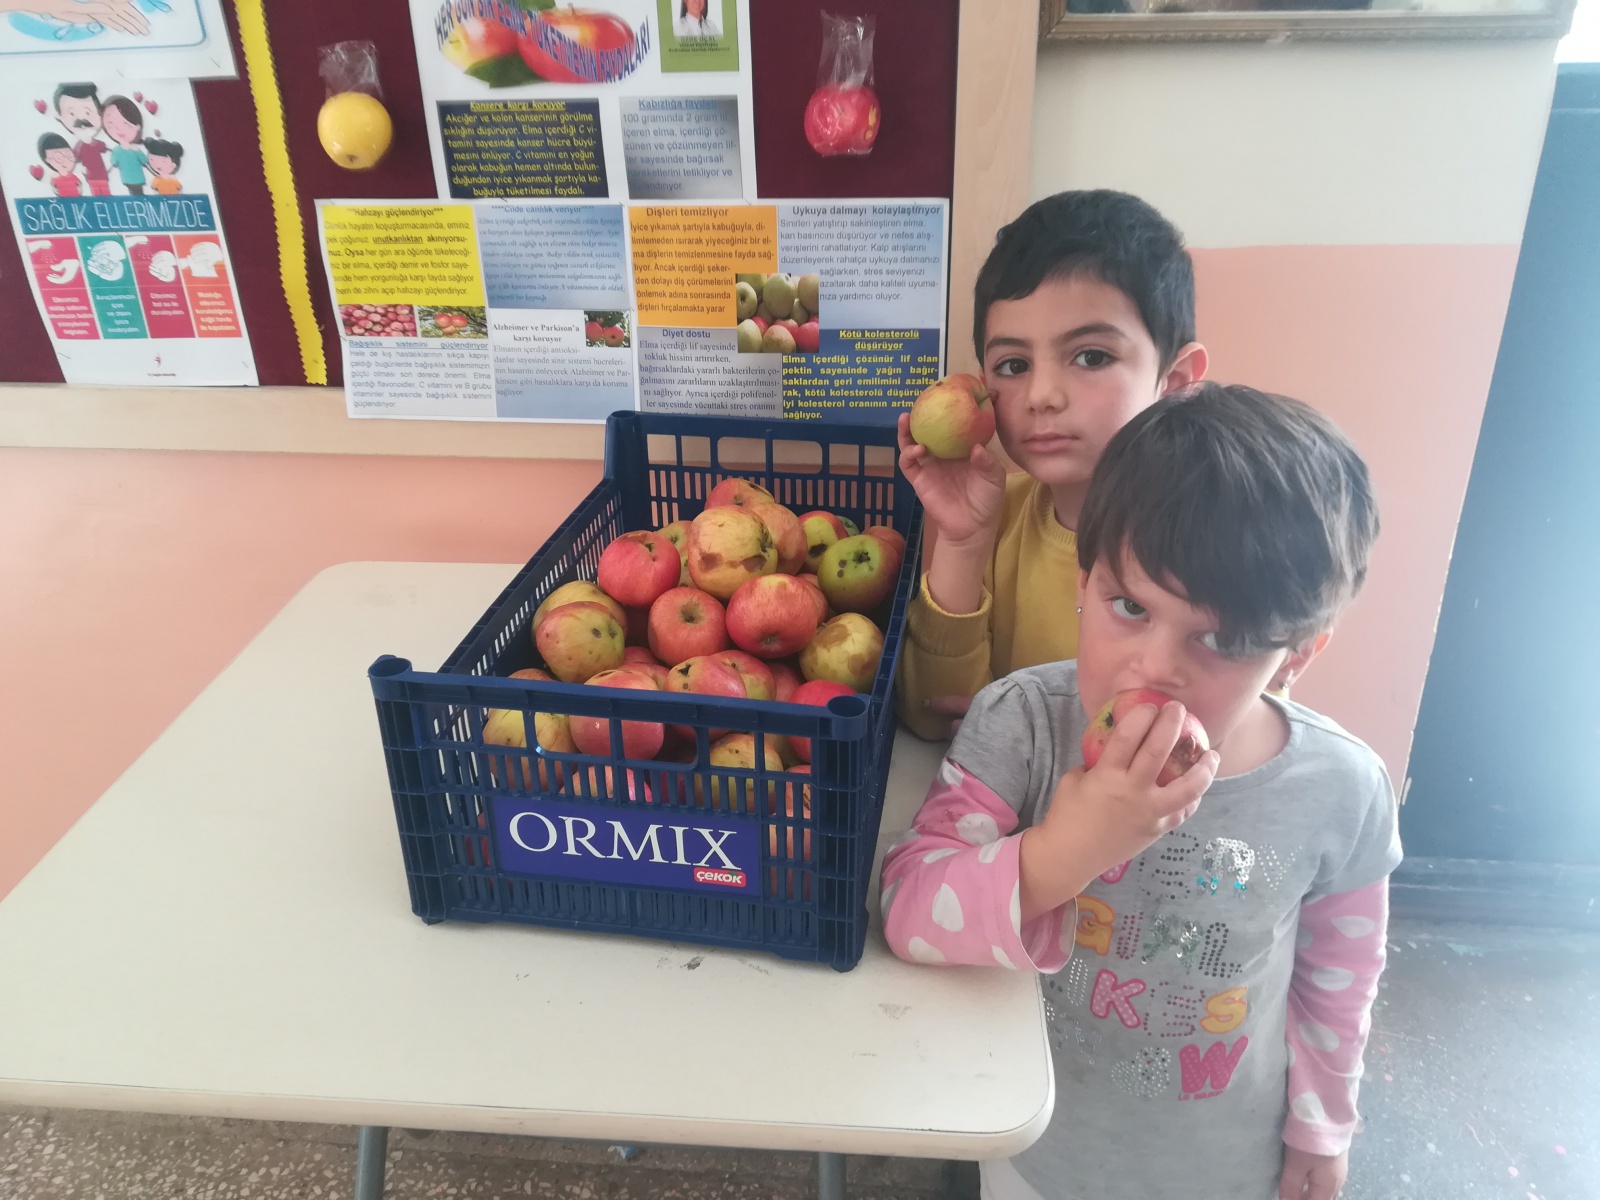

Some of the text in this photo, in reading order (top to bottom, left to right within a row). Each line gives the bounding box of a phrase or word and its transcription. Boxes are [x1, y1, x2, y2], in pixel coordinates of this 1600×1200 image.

[599, 15, 651, 84] FAYDALARI
[24, 198, 209, 231] SAĞLIK ELLERİMİZDE
[646, 208, 729, 218] Dişleri temizliyor
[793, 206, 940, 216] Uykuya dalmayı kolaylaştırıyor
[650, 222, 765, 232] yıkamak şartıyla kabuğuyla, di-
[781, 219, 900, 229] Sinirleri yatıştırıp sakinleştiren
[676, 236, 771, 246] ısırarak yiyeceğiniz bir el-
[837, 232, 877, 241] düşürüyor
[917, 232, 934, 241] alış-
[781, 244, 818, 252] verişlerini
[871, 244, 889, 253] Kalp
[892, 244, 926, 252] atışlarını
[647, 250, 673, 258] dişlerin
[675, 250, 732, 258] temizlenmesine
[735, 250, 756, 259] fayda
[758, 251, 774, 260] sağ-
[781, 255, 834, 265] düzenleyerek
[837, 256, 866, 264] rahatça
[869, 256, 898, 264] uykuya
[678, 264, 705, 274] içerdiği
[708, 265, 730, 273] şeker-
[820, 268, 860, 277] sağlarken,
[886, 268, 924, 277] seviyenizi
[651, 277, 672, 286] dolayı
[674, 278, 685, 286] diş
[687, 278, 733, 286] çürümelerini
[820, 280, 856, 288] azaltarak
[908, 281, 938, 289] uyuma-
[637, 290, 666, 298] önlemek
[839, 293, 873, 302] yardımcı
[876, 292, 902, 301] oluyor.
[638, 304, 725, 314] dişleri yarar
[663, 329, 710, 339] Diyet dostu
[839, 330, 919, 339] Kötü kolesterolü
[700, 343, 735, 352] sayesinde
[855, 342, 903, 350] düşürüyor
[813, 355, 848, 365] içerdiği
[856, 356, 893, 364] çözünür
[783, 366, 938, 375] pektin sayesinde yağın bağır-
[834, 378, 852, 387] geri
[711, 390, 738, 399] içerdiği
[783, 389, 801, 398] rak,
[783, 411, 822, 419] sağlıyor.
[509, 812, 741, 870] ORMIX
